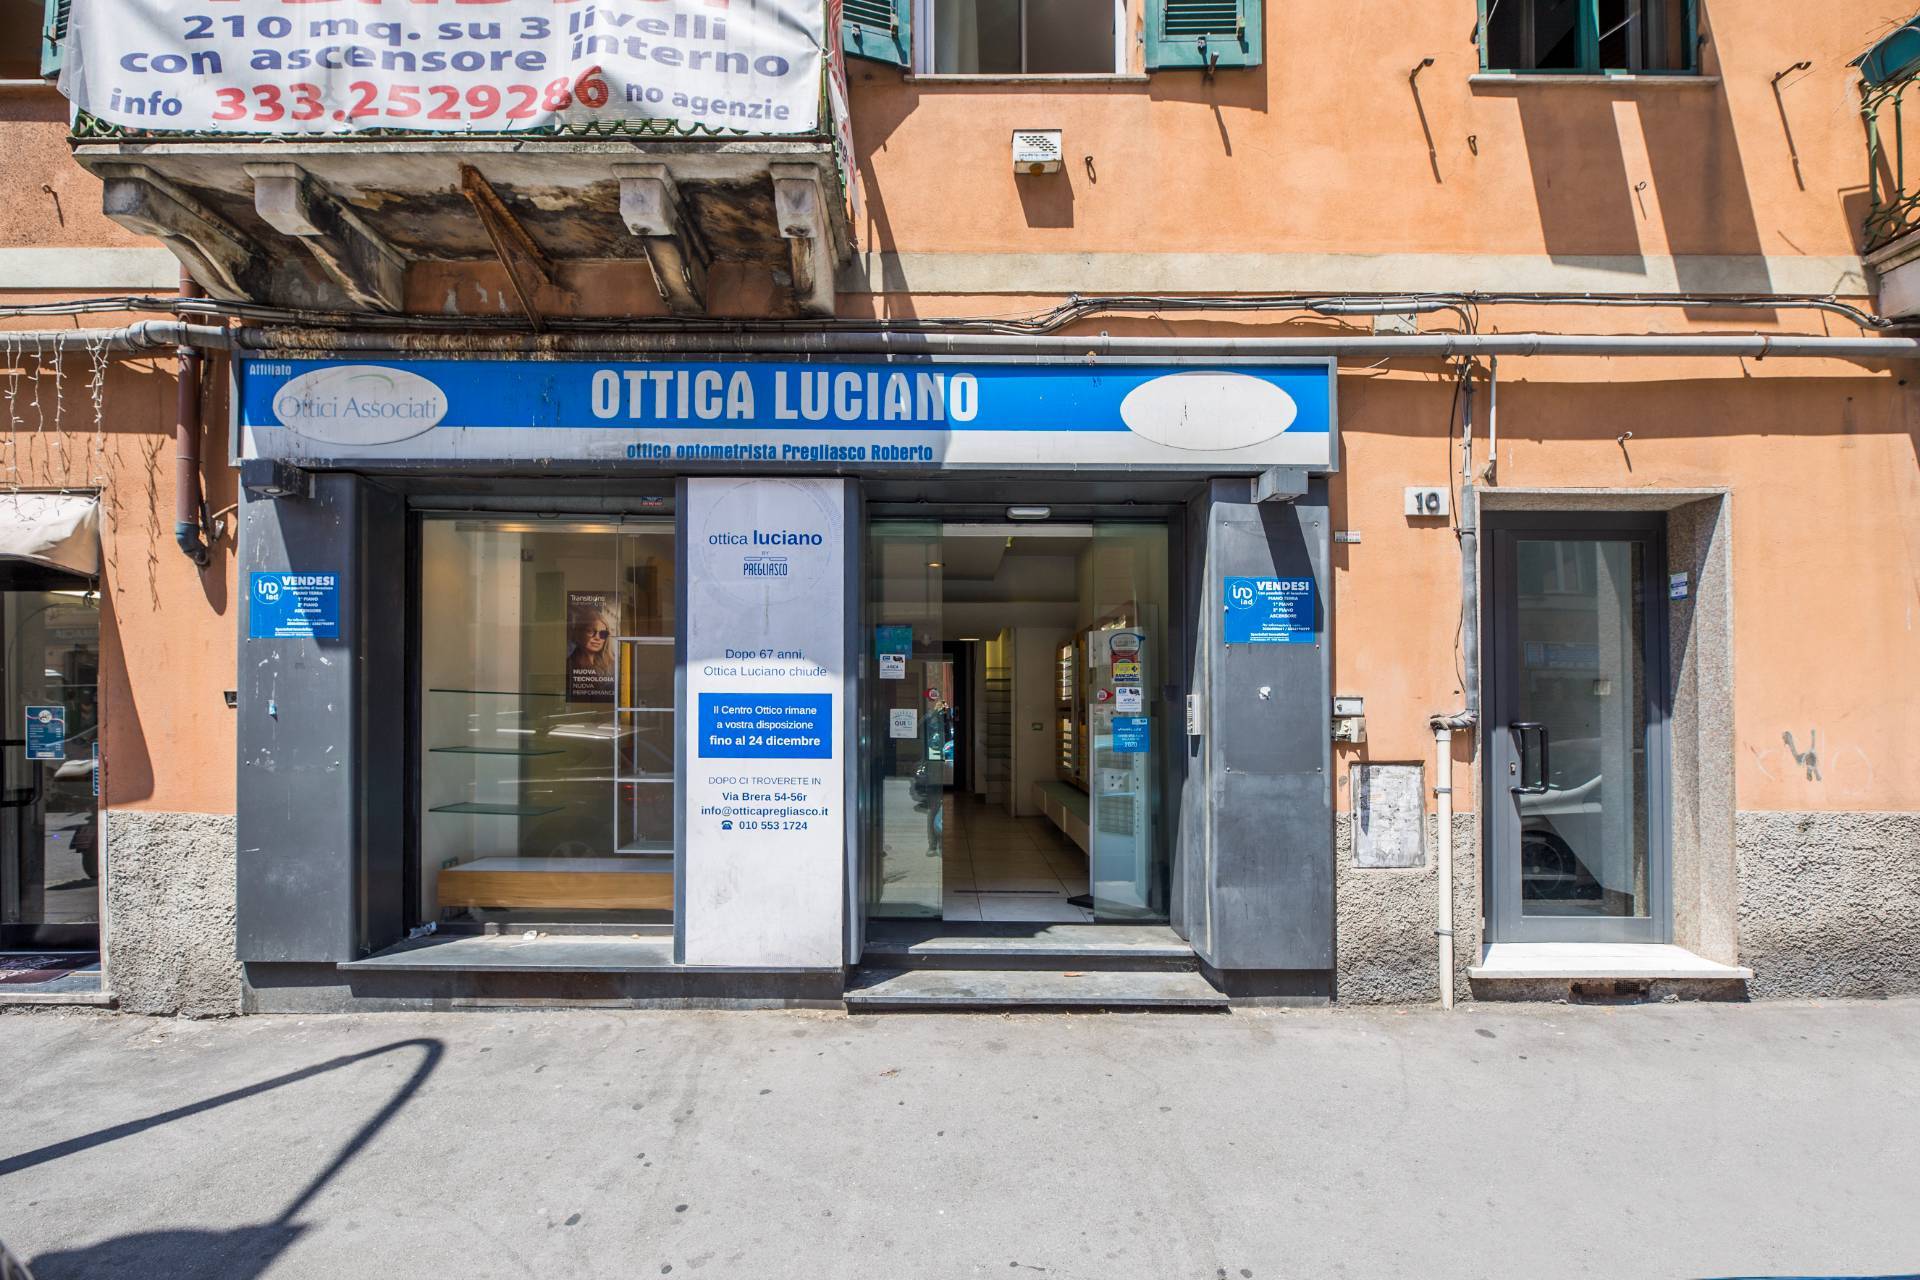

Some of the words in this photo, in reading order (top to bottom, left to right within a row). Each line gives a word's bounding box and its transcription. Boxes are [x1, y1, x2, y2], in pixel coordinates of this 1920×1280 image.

[183, 15, 292, 40] 210
[310, 17, 421, 46] mq.
[438, 19, 500, 41] su
[519, 16, 552, 41] 3
[568, 5, 726, 41] livelli
[120, 50, 223, 75] con
[250, 44, 547, 73] ascensore
[571, 32, 789, 77] interno
[110, 87, 183, 117] info
[211, 65, 609, 122] 333.2529286
[625, 81, 663, 103] no
[671, 88, 789, 121] agenzie
[249, 363, 292, 376] Affiliato
[591, 369, 755, 420] OTTICA
[774, 370, 979, 422] LUCIANO
[277, 395, 338, 419] Ottici
[342, 396, 438, 419] Associati
[626, 442, 672, 460] ottico
[676, 442, 777, 461] optometrista
[781, 443, 866, 462] Pregliasco
[870, 444, 933, 462] Roberto
[708, 531, 749, 545] ottica
[753, 530, 823, 546] luciano
[743, 562, 788, 576] PREGLIASCO
[281, 576, 335, 586] VENDESI
[1256, 581, 1310, 591] VENDESI
[725, 648, 756, 661] Dopo
[759, 649, 774, 659] 67
[777, 649, 805, 661] anni,
[703, 665, 737, 676] Ottica
[740, 665, 786, 676] Luciano
[789, 666, 827, 677] chiude
[713, 705, 719, 714] Il
[721, 705, 752, 715] Centro
[755, 705, 783, 715] Ottico
[785, 705, 817, 715] rimane
[716, 721, 723, 729] a
[724, 720, 753, 729] vostra
[756, 720, 814, 731] disposizione
[709, 735, 732, 746] fino
[735, 735, 746, 746] al
[749, 735, 763, 746] 24
[766, 735, 821, 746] dicembre
[708, 776, 737, 785] DOPO
[738, 776, 749, 785] CI
[751, 776, 809, 785] TROVERETE
[811, 777, 822, 785] IN
[722, 791, 740, 801] Via
[742, 792, 771, 801] Brera
[774, 792, 808, 801] 54-56r
[701, 805, 829, 818] info@otticapregliasco.it
[739, 820, 758, 830] 010
[760, 820, 780, 830] 553
[782, 821, 808, 830] 1724
